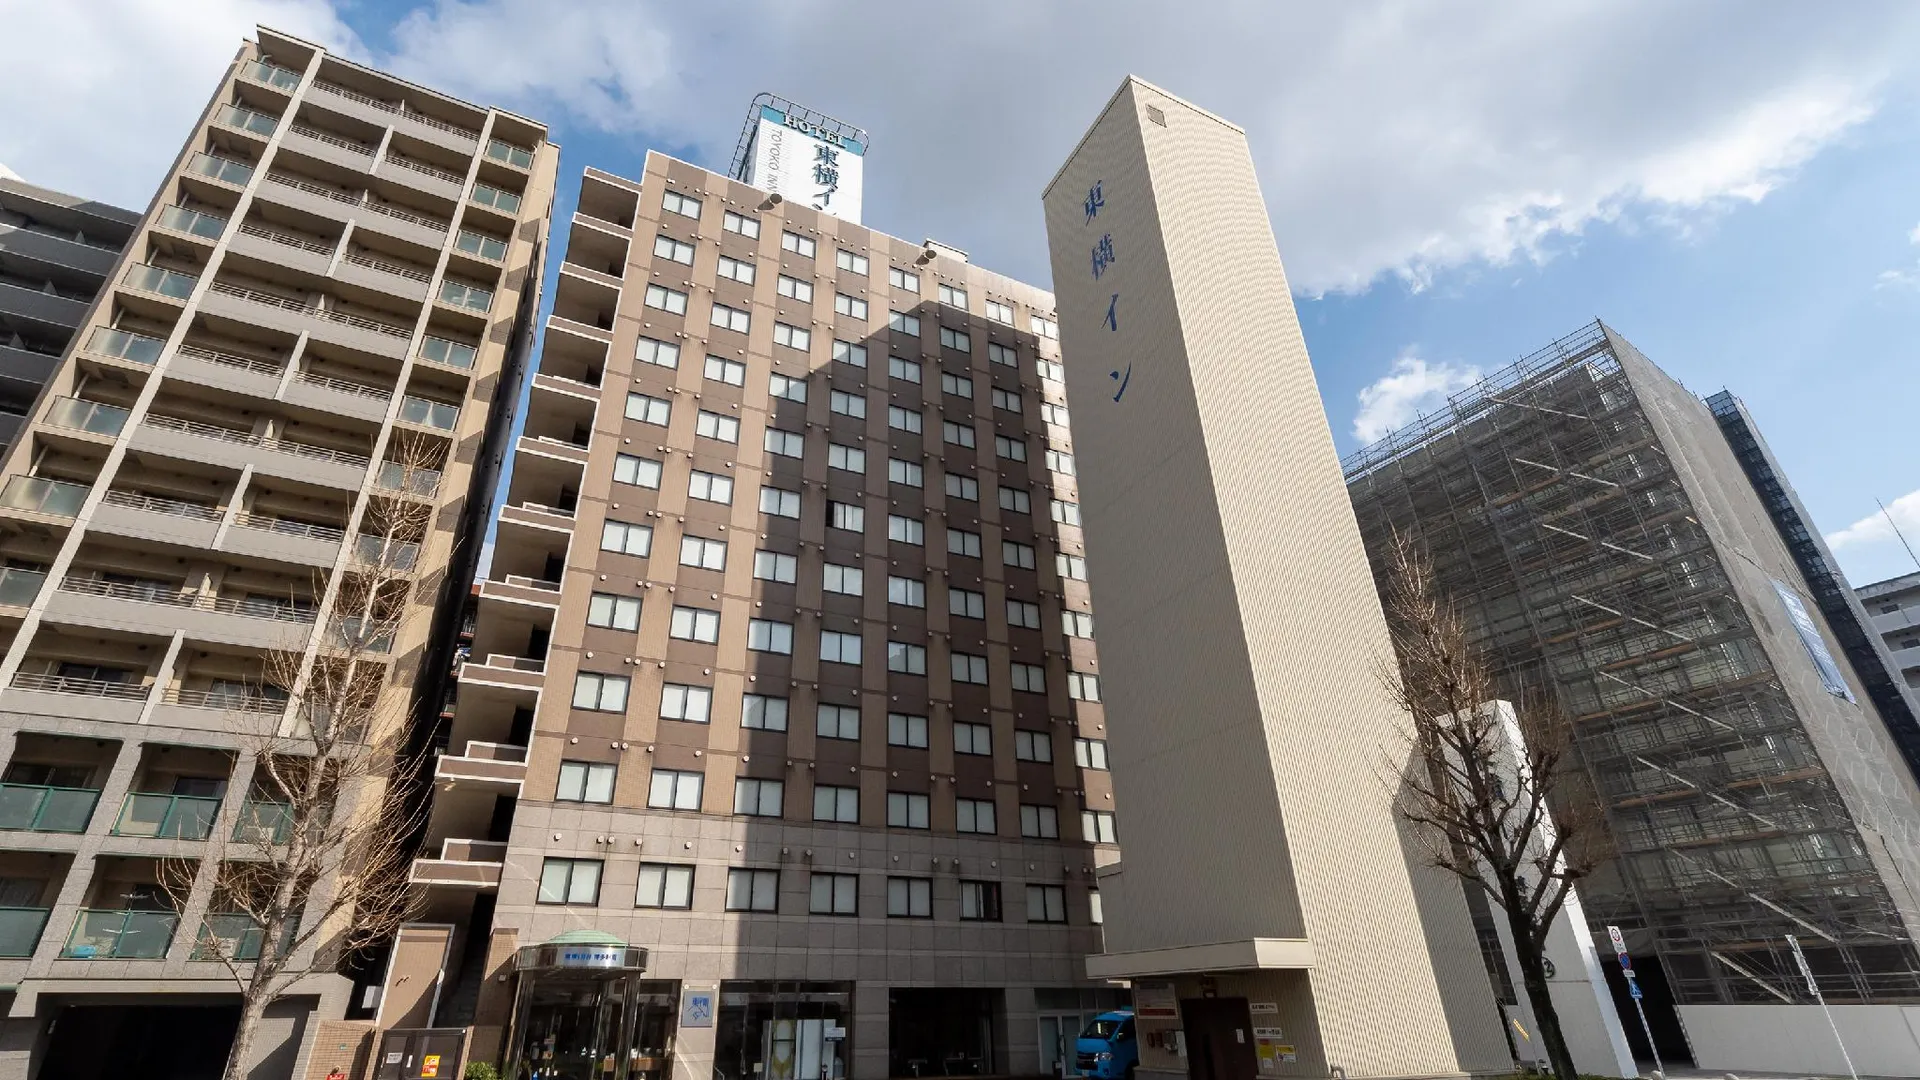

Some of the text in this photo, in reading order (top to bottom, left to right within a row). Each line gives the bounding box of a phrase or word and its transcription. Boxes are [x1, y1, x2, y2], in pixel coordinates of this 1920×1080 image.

[769, 129, 783, 170] TOYOKO
[784, 114, 847, 149] HOTEL
[1083, 179, 1132, 403] 東横イン
